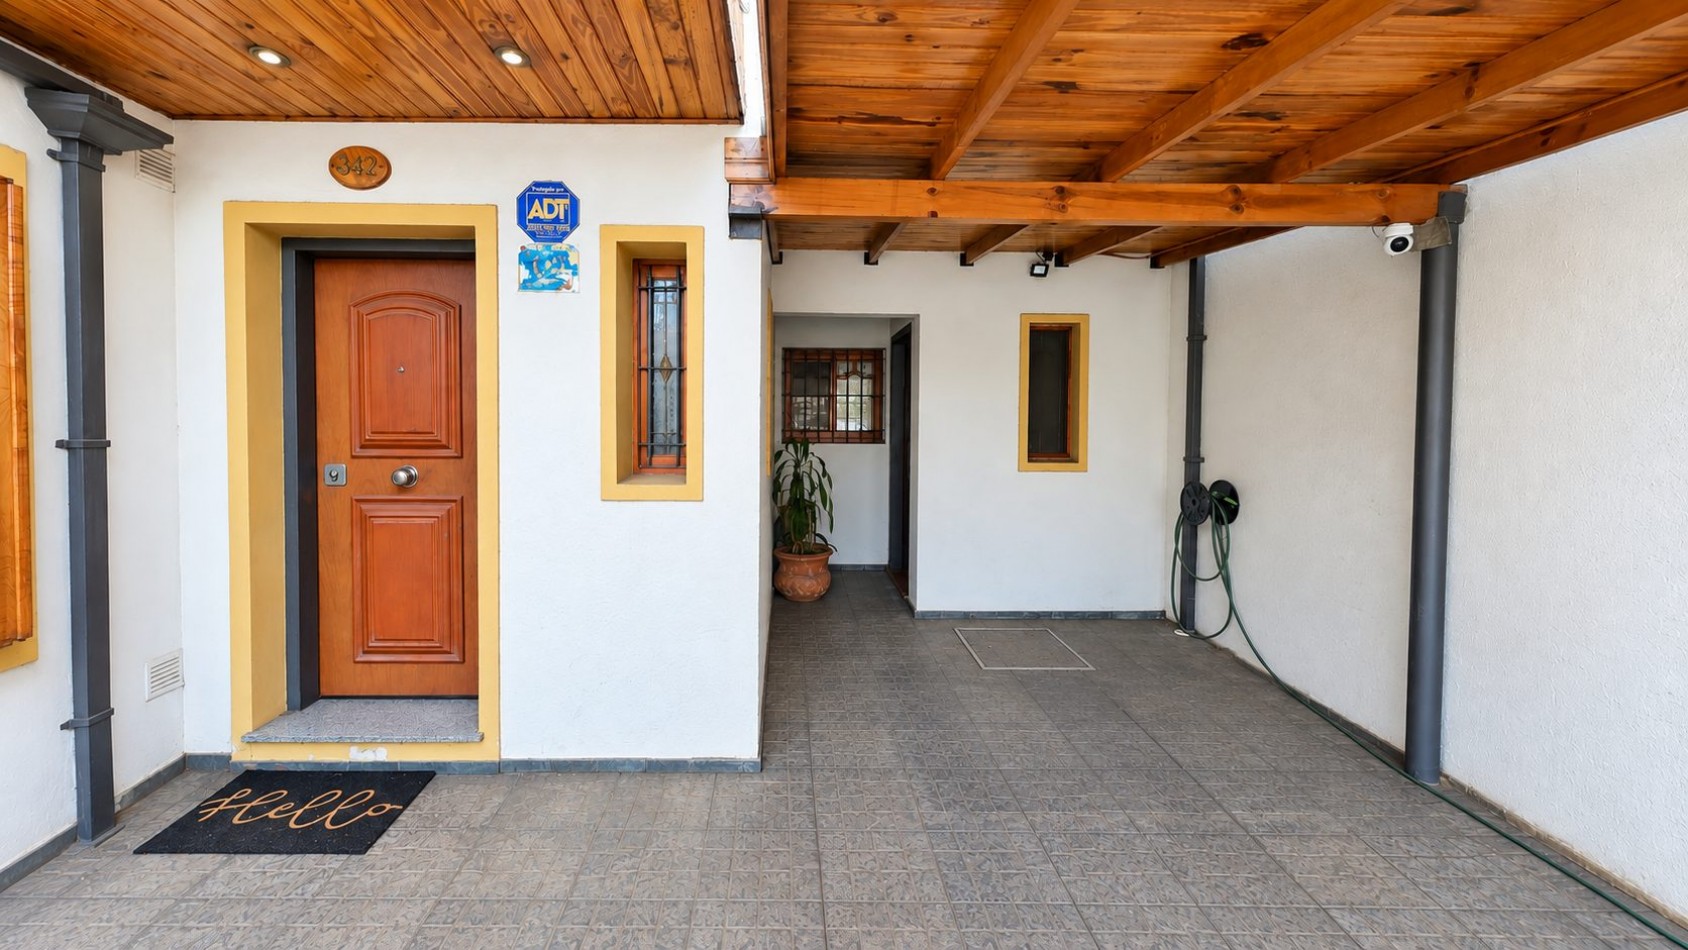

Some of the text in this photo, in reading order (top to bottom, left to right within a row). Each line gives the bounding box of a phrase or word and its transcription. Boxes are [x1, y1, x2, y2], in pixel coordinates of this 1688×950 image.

[336, 154, 378, 177] 342
[528, 198, 569, 220] ADT
[198, 788, 403, 830] Hello
